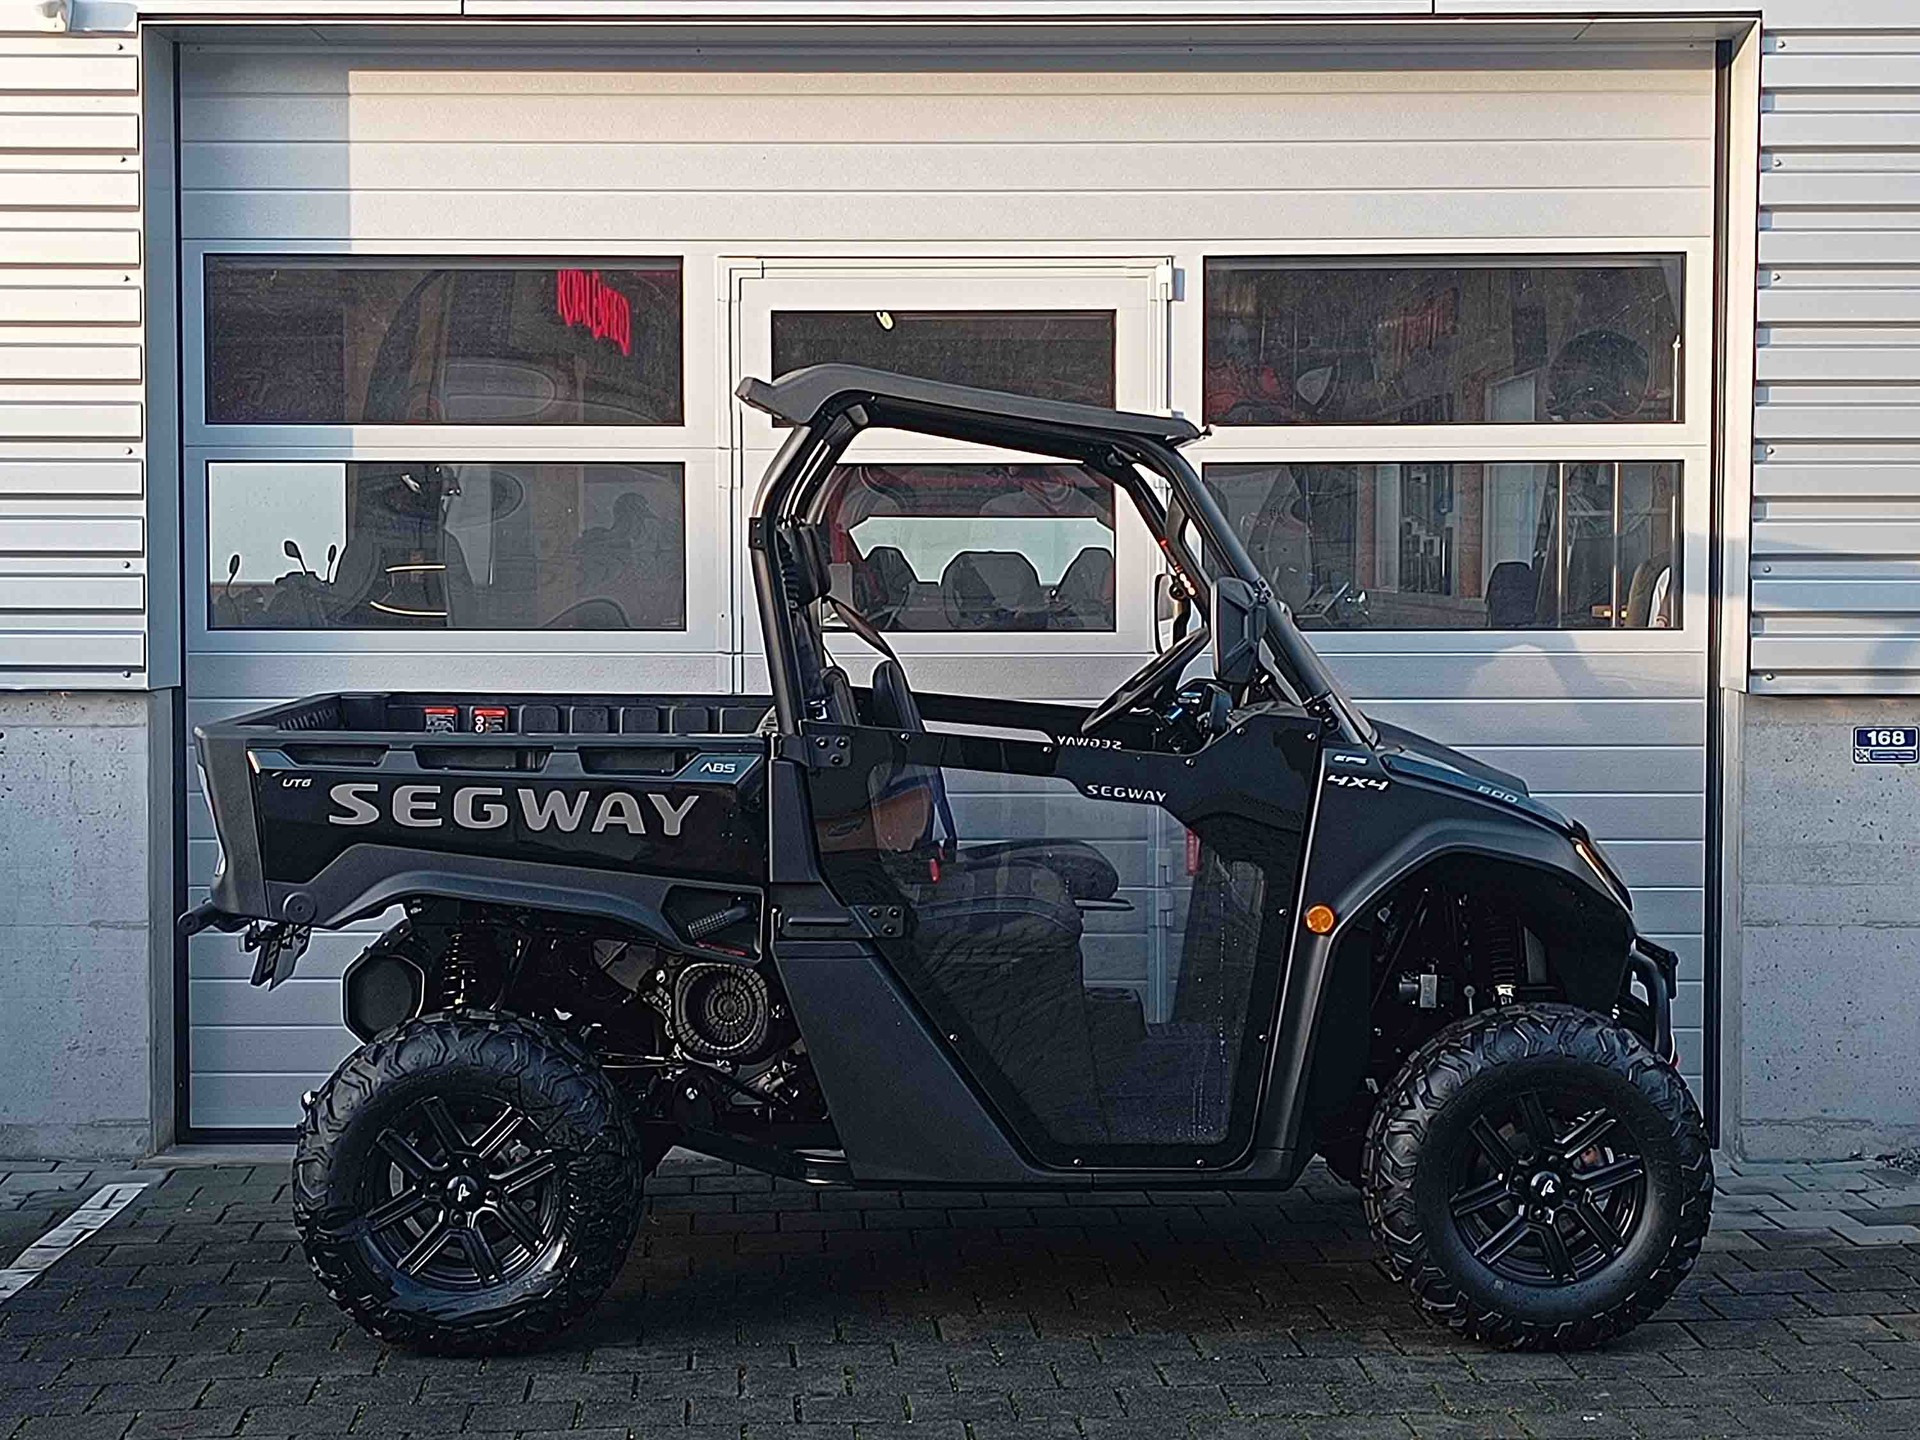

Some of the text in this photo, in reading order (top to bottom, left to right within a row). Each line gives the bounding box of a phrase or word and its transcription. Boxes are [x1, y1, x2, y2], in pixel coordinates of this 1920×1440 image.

[1867, 730, 1905, 745] 168
[700, 762, 736, 773] ABS
[282, 778, 312, 788] UT6
[1086, 784, 1167, 803] SEGWAY
[328, 783, 700, 837] SEGWAY
